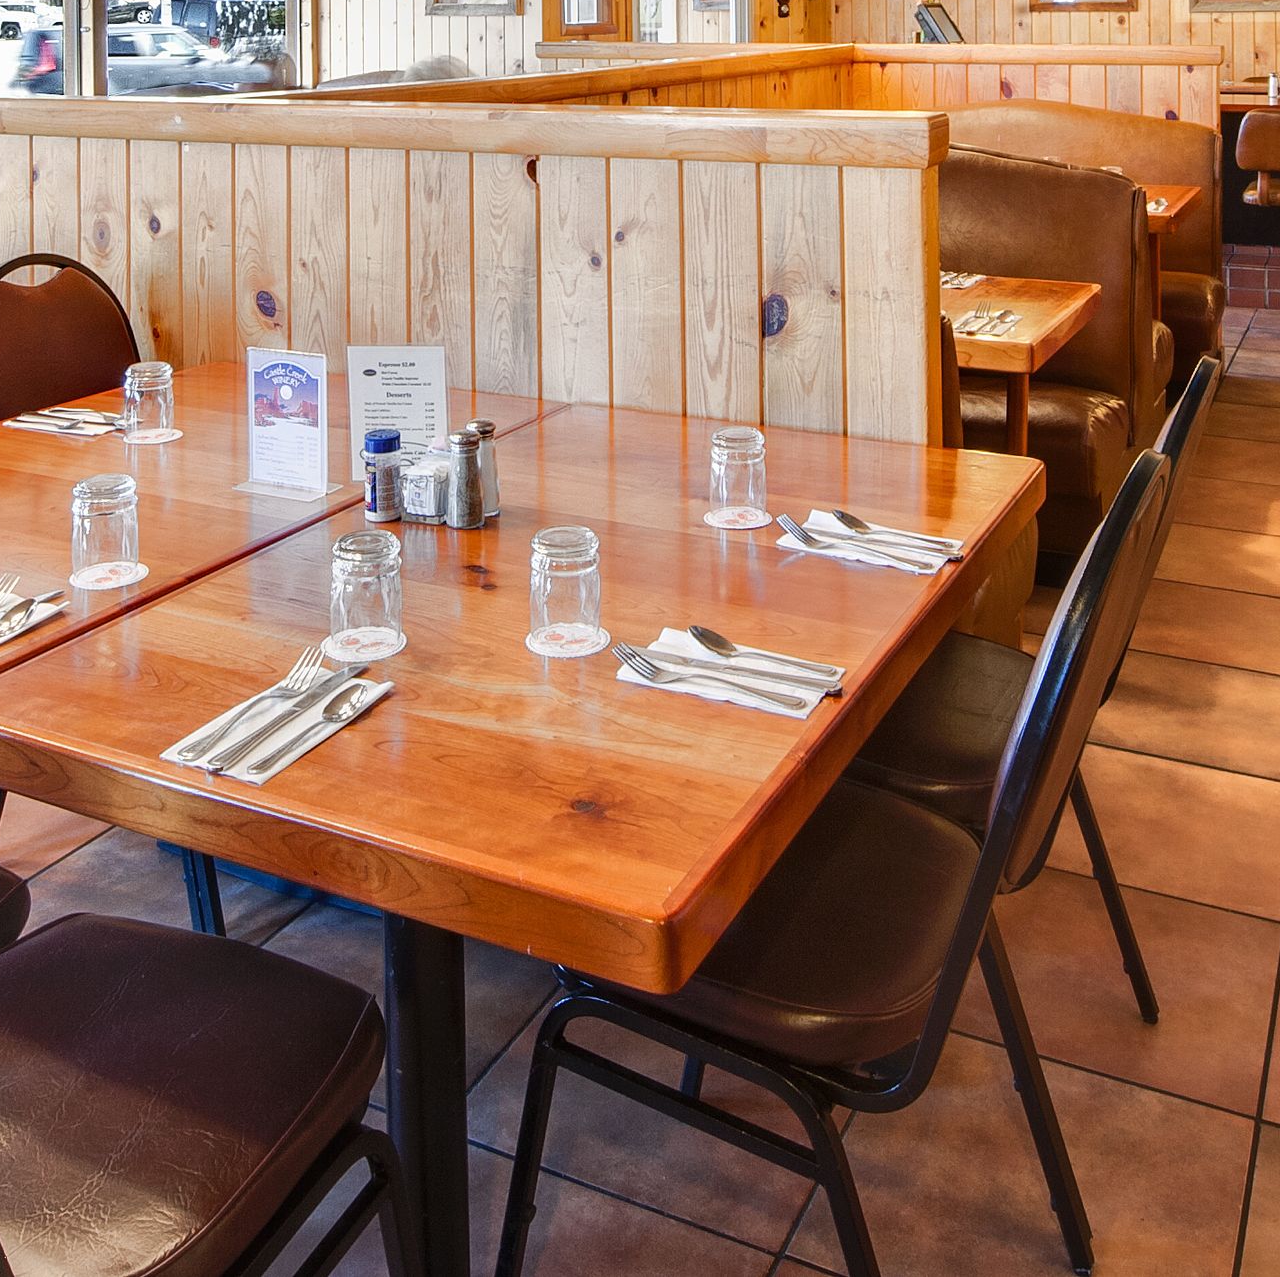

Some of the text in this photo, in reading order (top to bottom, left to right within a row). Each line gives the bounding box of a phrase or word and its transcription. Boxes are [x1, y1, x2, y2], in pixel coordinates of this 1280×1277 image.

[264, 364, 308, 384] Castle Creek
[272, 376, 300, 388] WINERY
